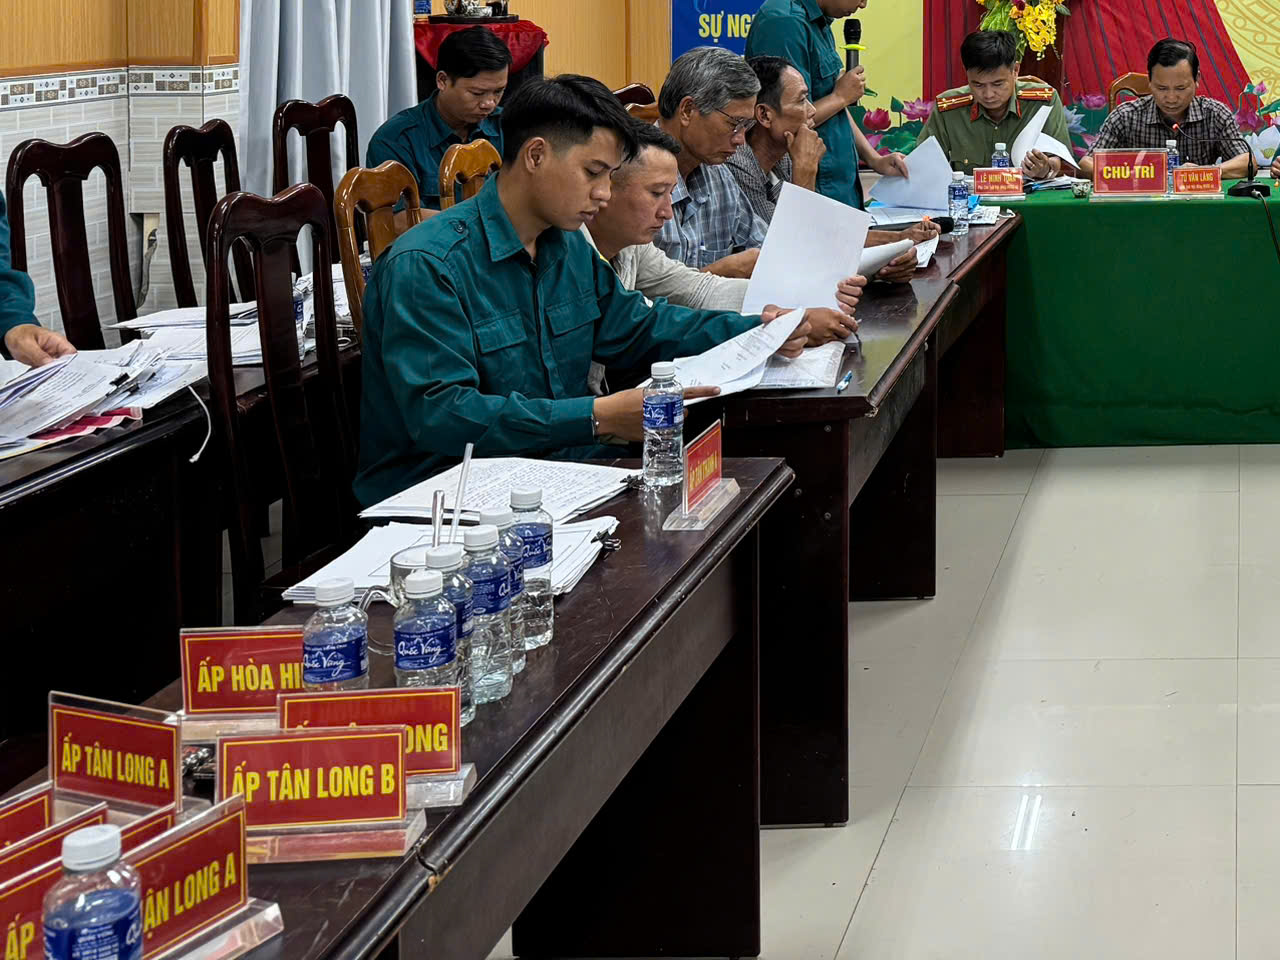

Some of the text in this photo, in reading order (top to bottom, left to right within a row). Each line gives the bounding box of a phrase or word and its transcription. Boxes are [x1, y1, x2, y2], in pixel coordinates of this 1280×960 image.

[698, 10, 756, 43] SỰ NG
[1103, 161, 1155, 180] CHỦ TRÌ
[197, 656, 303, 692] ẤP HÒA HI
[405, 723, 449, 754] ONG
[61, 735, 170, 789] ẤP TÂN LONG A
[232, 760, 395, 804] ẤP TÂN LONG B
[142, 888, 170, 939] ẬN
[174, 860, 221, 916] LONG
[224, 851, 237, 889] A
[4, 913, 35, 960] ẤP
